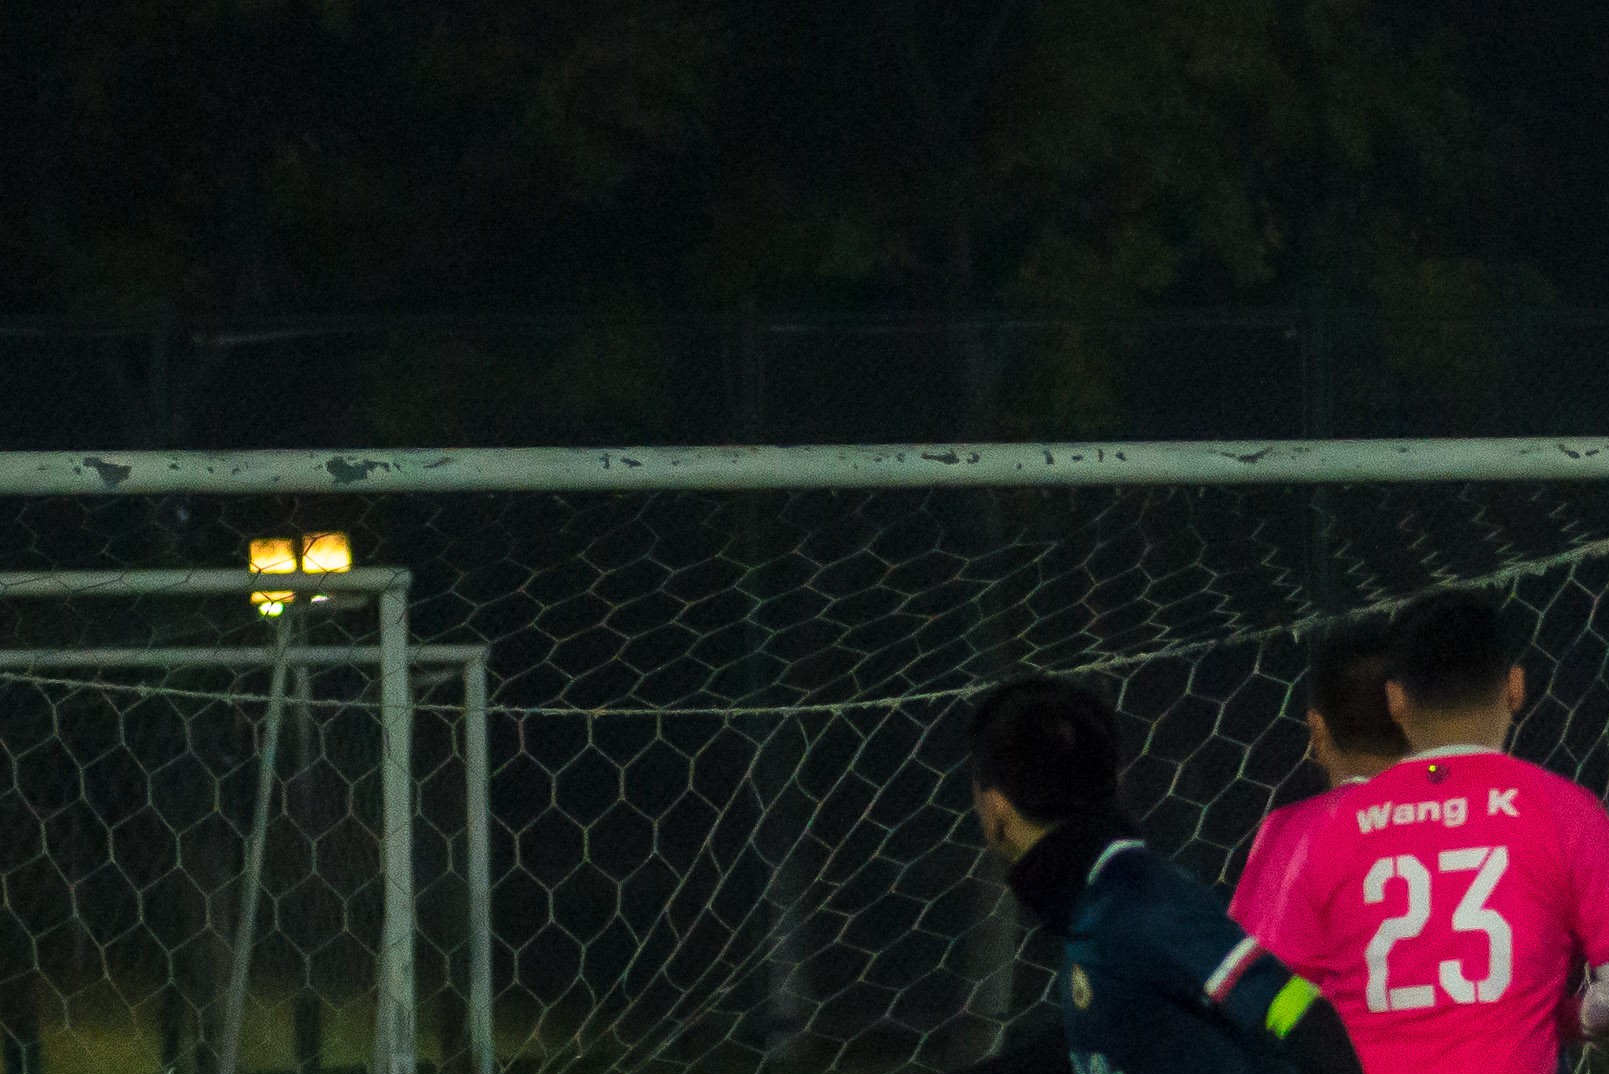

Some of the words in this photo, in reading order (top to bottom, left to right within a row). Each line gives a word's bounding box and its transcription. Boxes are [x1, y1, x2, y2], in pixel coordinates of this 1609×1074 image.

[1356, 797, 1468, 834] Wang
[1486, 788, 1520, 817] K
[1363, 846, 1513, 1013] 23
